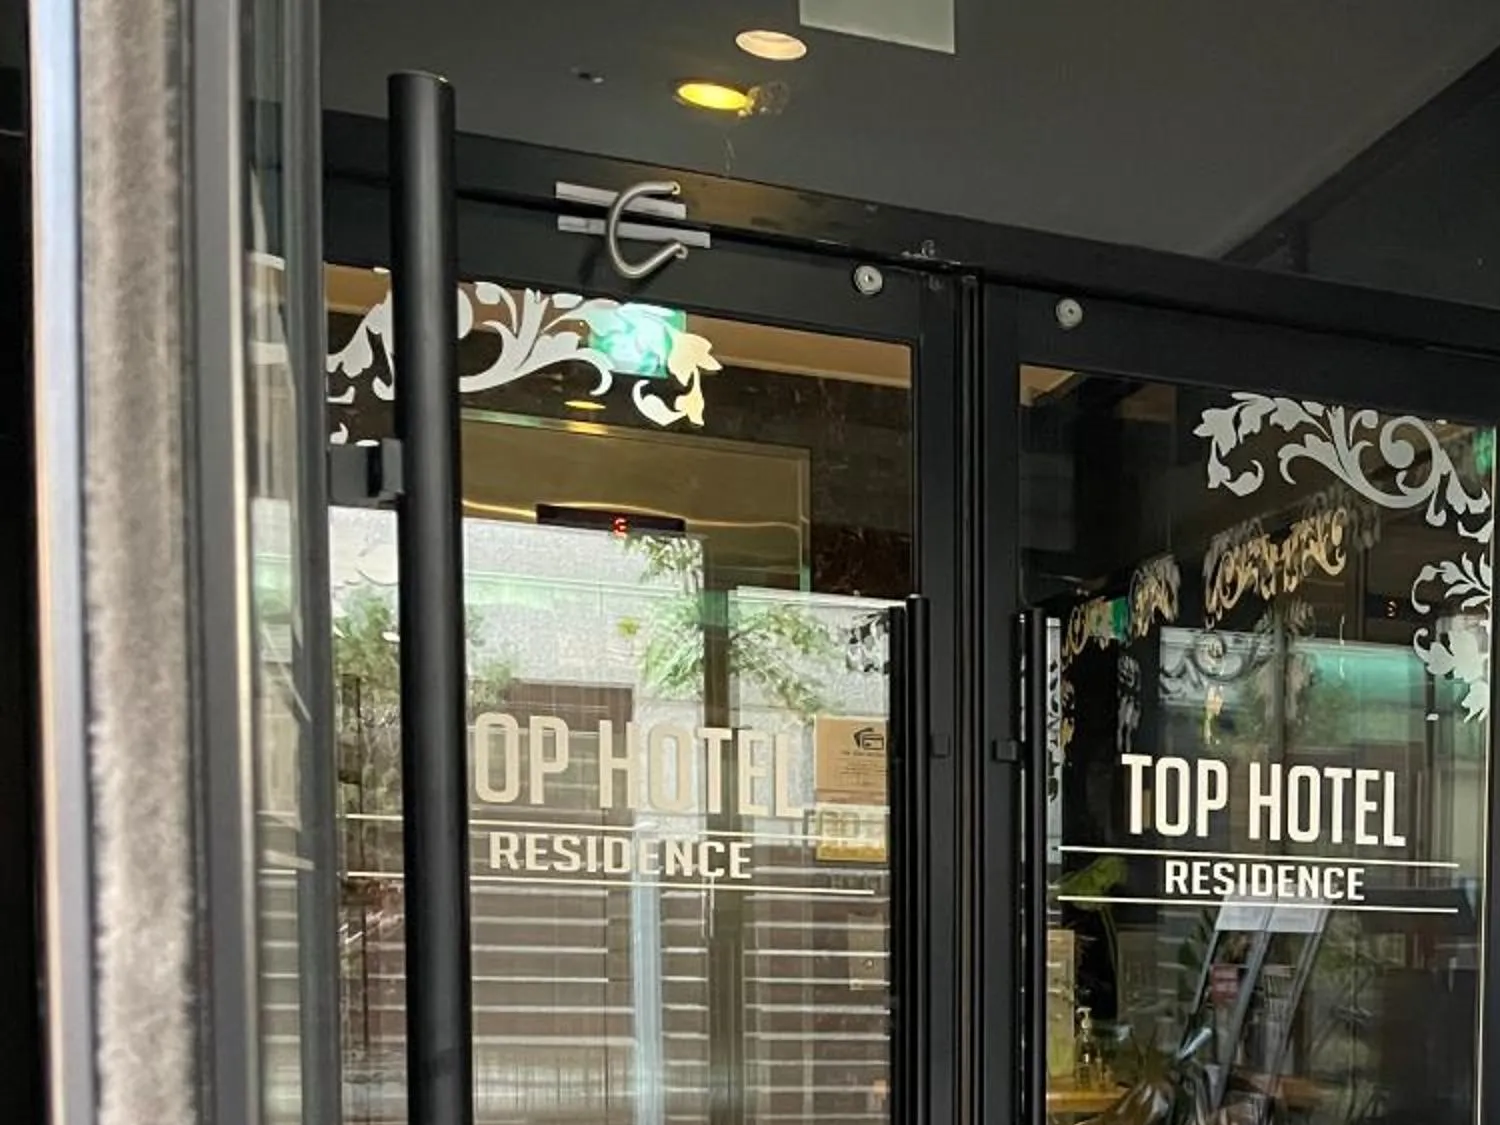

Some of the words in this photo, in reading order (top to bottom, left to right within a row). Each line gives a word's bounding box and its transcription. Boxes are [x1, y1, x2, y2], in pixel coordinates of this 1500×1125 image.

[475, 712, 569, 804] OP
[600, 719, 802, 818] HOTEL
[1121, 754, 1228, 837] TOP
[1249, 762, 1406, 846] HOTEL
[489, 832, 752, 880] RESIDENCE
[1165, 860, 1365, 901] RESIDENCE
